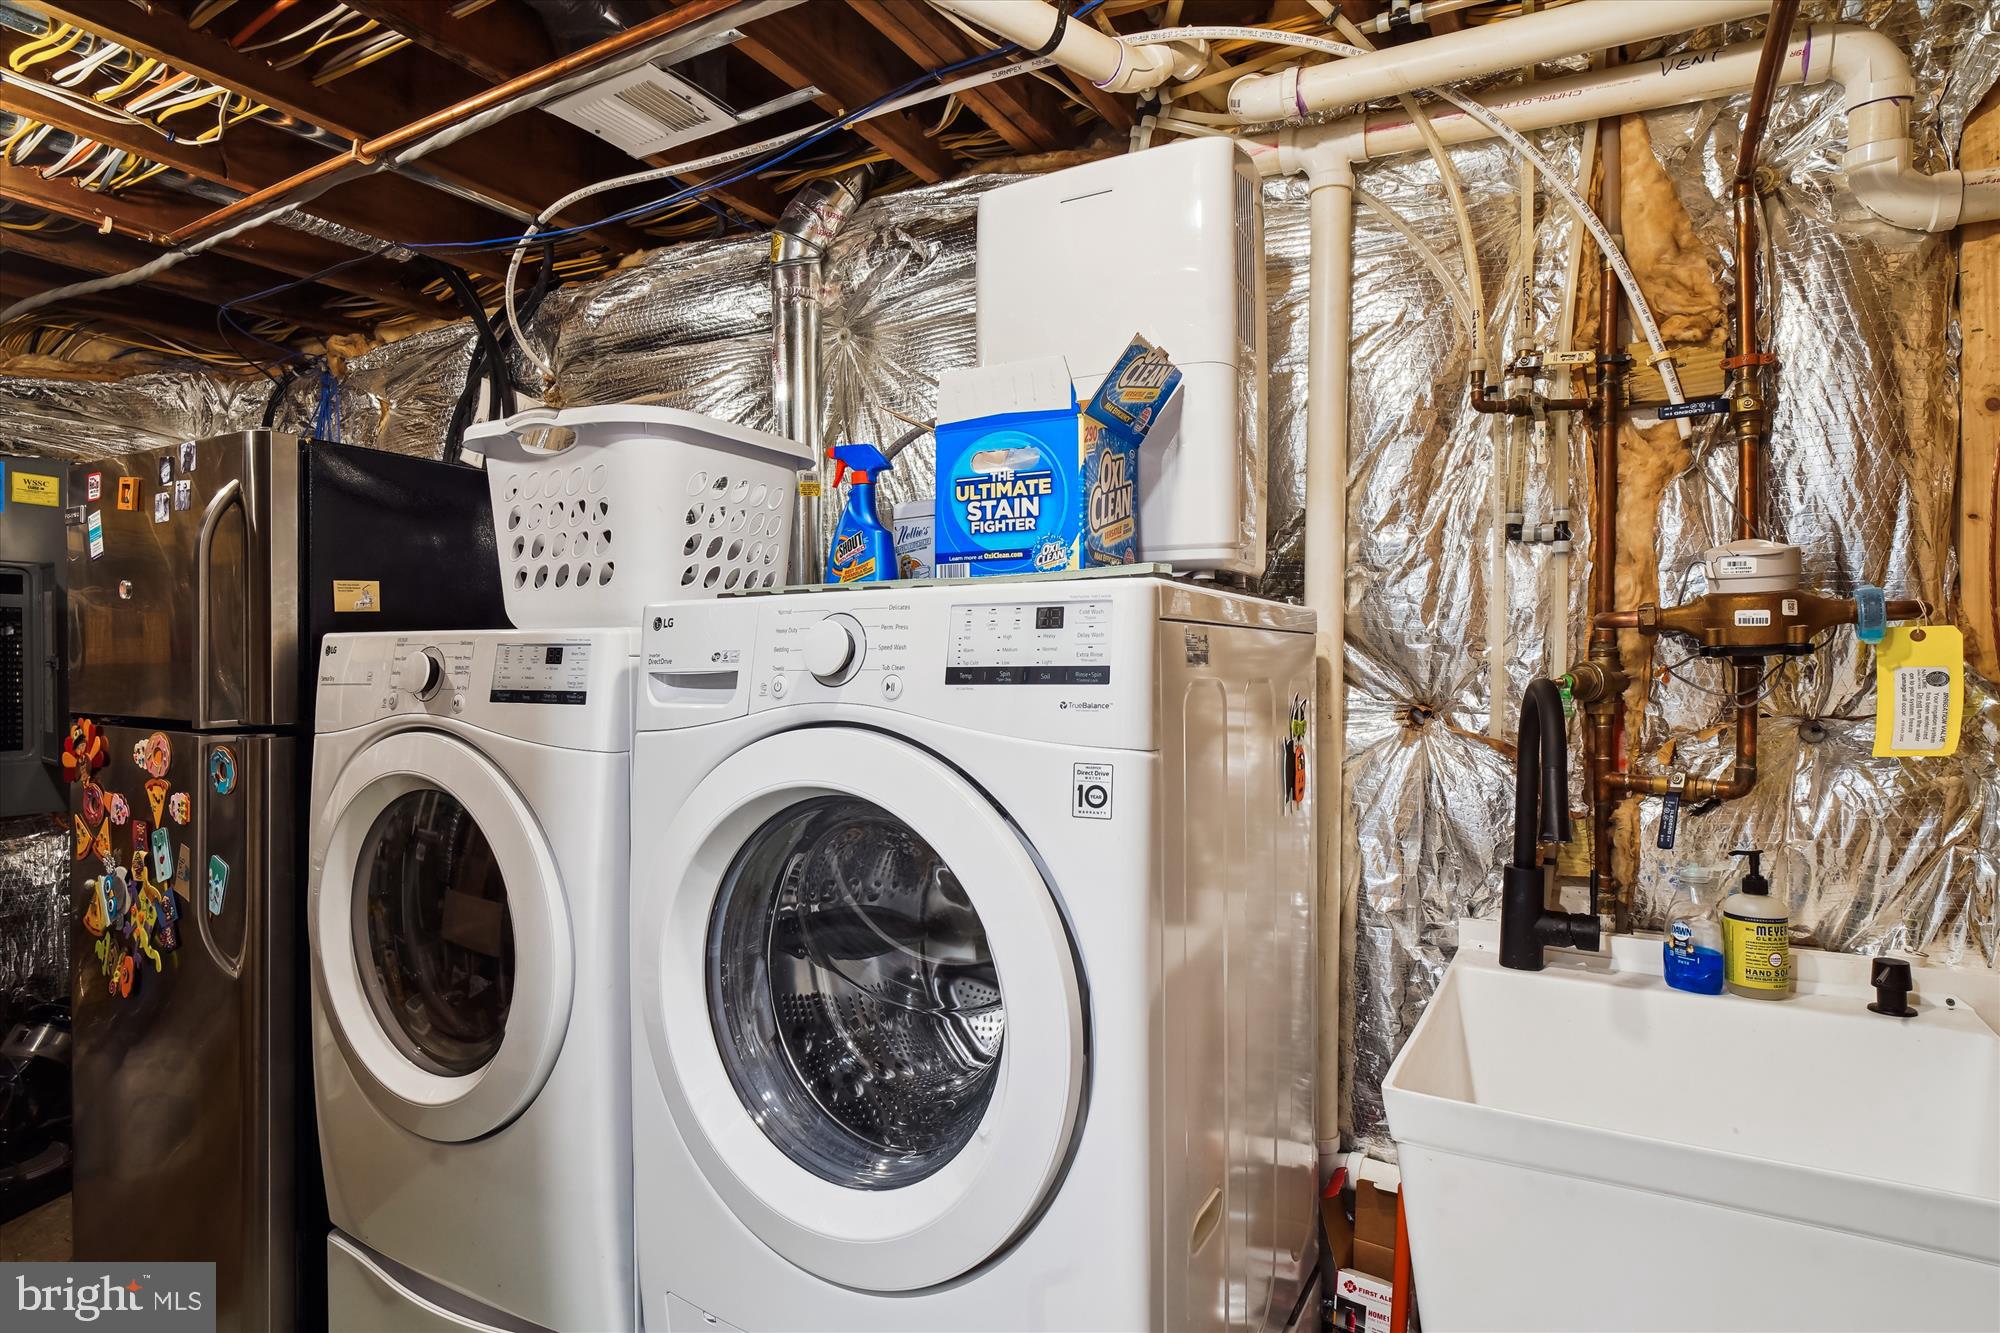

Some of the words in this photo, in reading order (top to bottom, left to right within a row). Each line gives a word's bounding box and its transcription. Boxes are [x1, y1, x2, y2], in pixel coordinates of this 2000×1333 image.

[1660, 50, 1729, 77] VENT
[990, 470, 1015, 482] THE
[1100, 451, 1125, 493] OXI
[23, 478, 49, 488] WSSC
[956, 478, 1052, 502] ULTIMATE
[967, 496, 1039, 521] STAIN
[1091, 485, 1132, 533] CLEAN
[971, 517, 1036, 535] FIGHTER
[895, 525, 929, 545] Nellie's
[983, 552, 1023, 560] OxiClean.com
[1036, 550, 1065, 566] CLEAN
[999, 670, 1011, 678] Spin
[1040, 672, 1051, 680] Soil
[1941, 691, 1949, 725] IRRIGATION
[1939, 725, 1948, 743] VALVE
[1077, 784, 1108, 809] 10
[1671, 924, 1692, 937] DAWN
[1745, 968, 1772, 977] HAND
[1358, 1287, 1379, 1298] FIRST
[1368, 1309, 1390, 1323] HOME1
